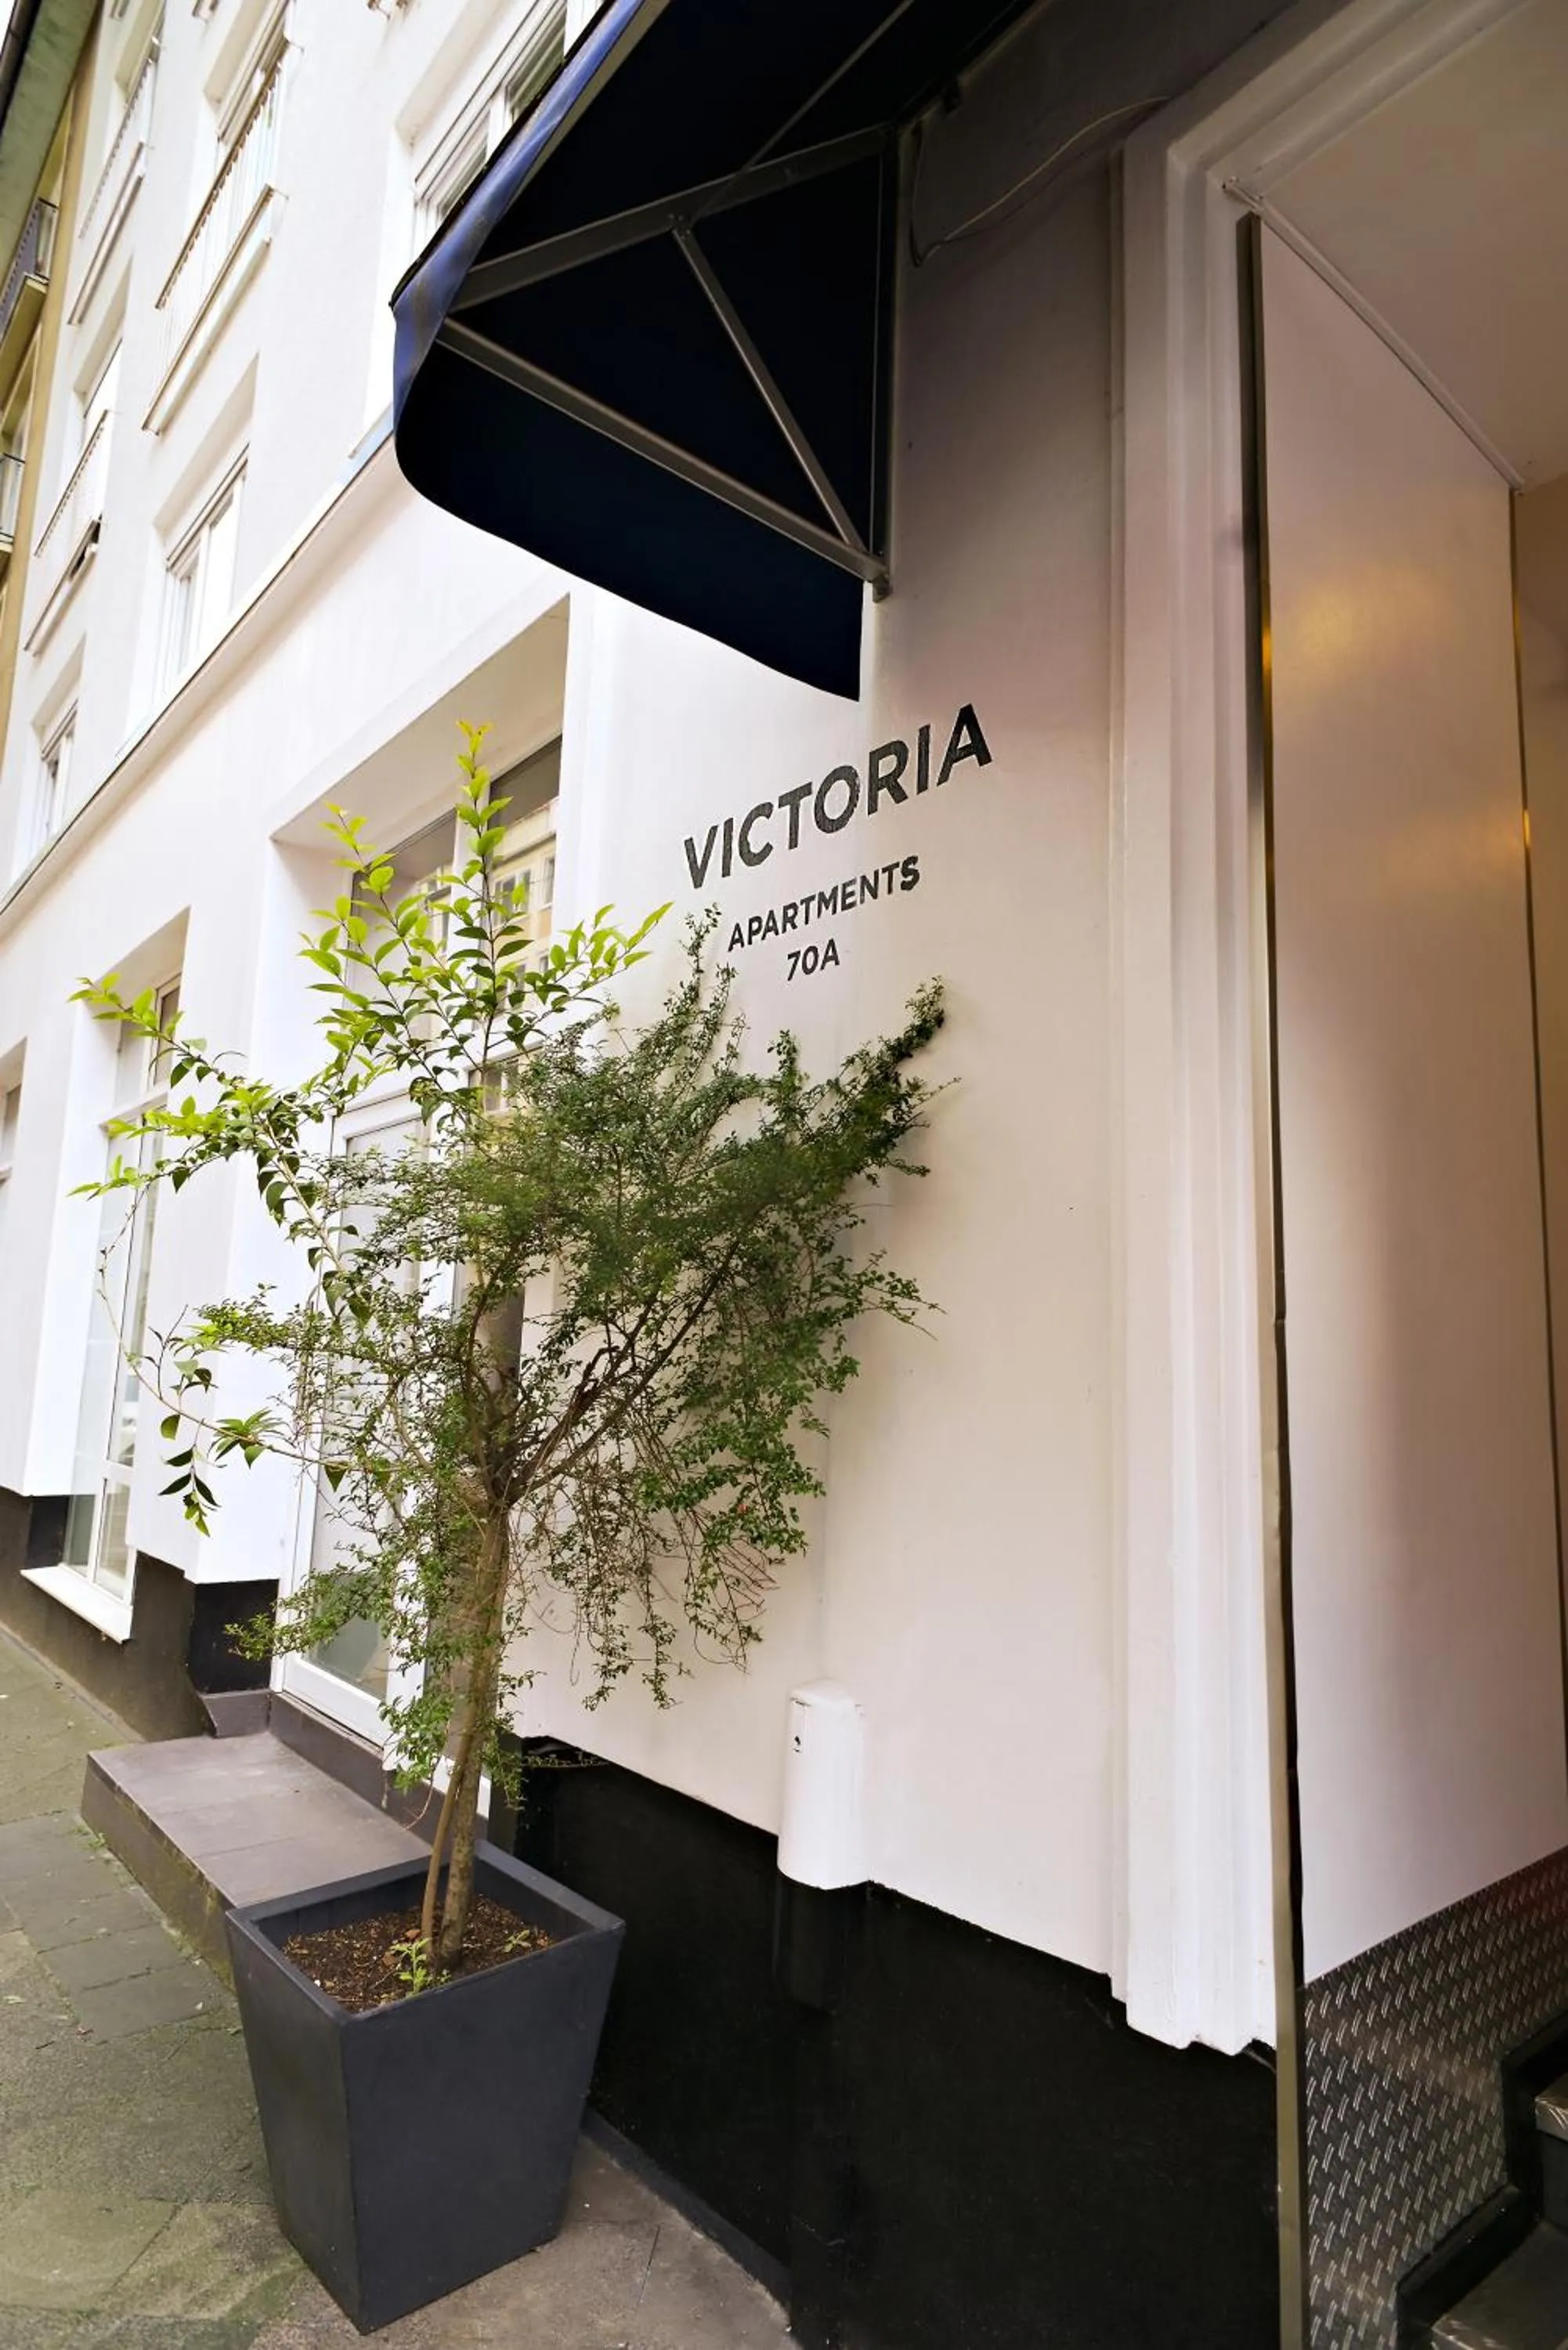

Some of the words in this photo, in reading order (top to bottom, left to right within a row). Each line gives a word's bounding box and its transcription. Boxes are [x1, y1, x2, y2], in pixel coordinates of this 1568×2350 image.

[684, 703, 993, 889] VICTORIA
[728, 855, 920, 953] APARTMENTS
[786, 938, 840, 982] 70A
